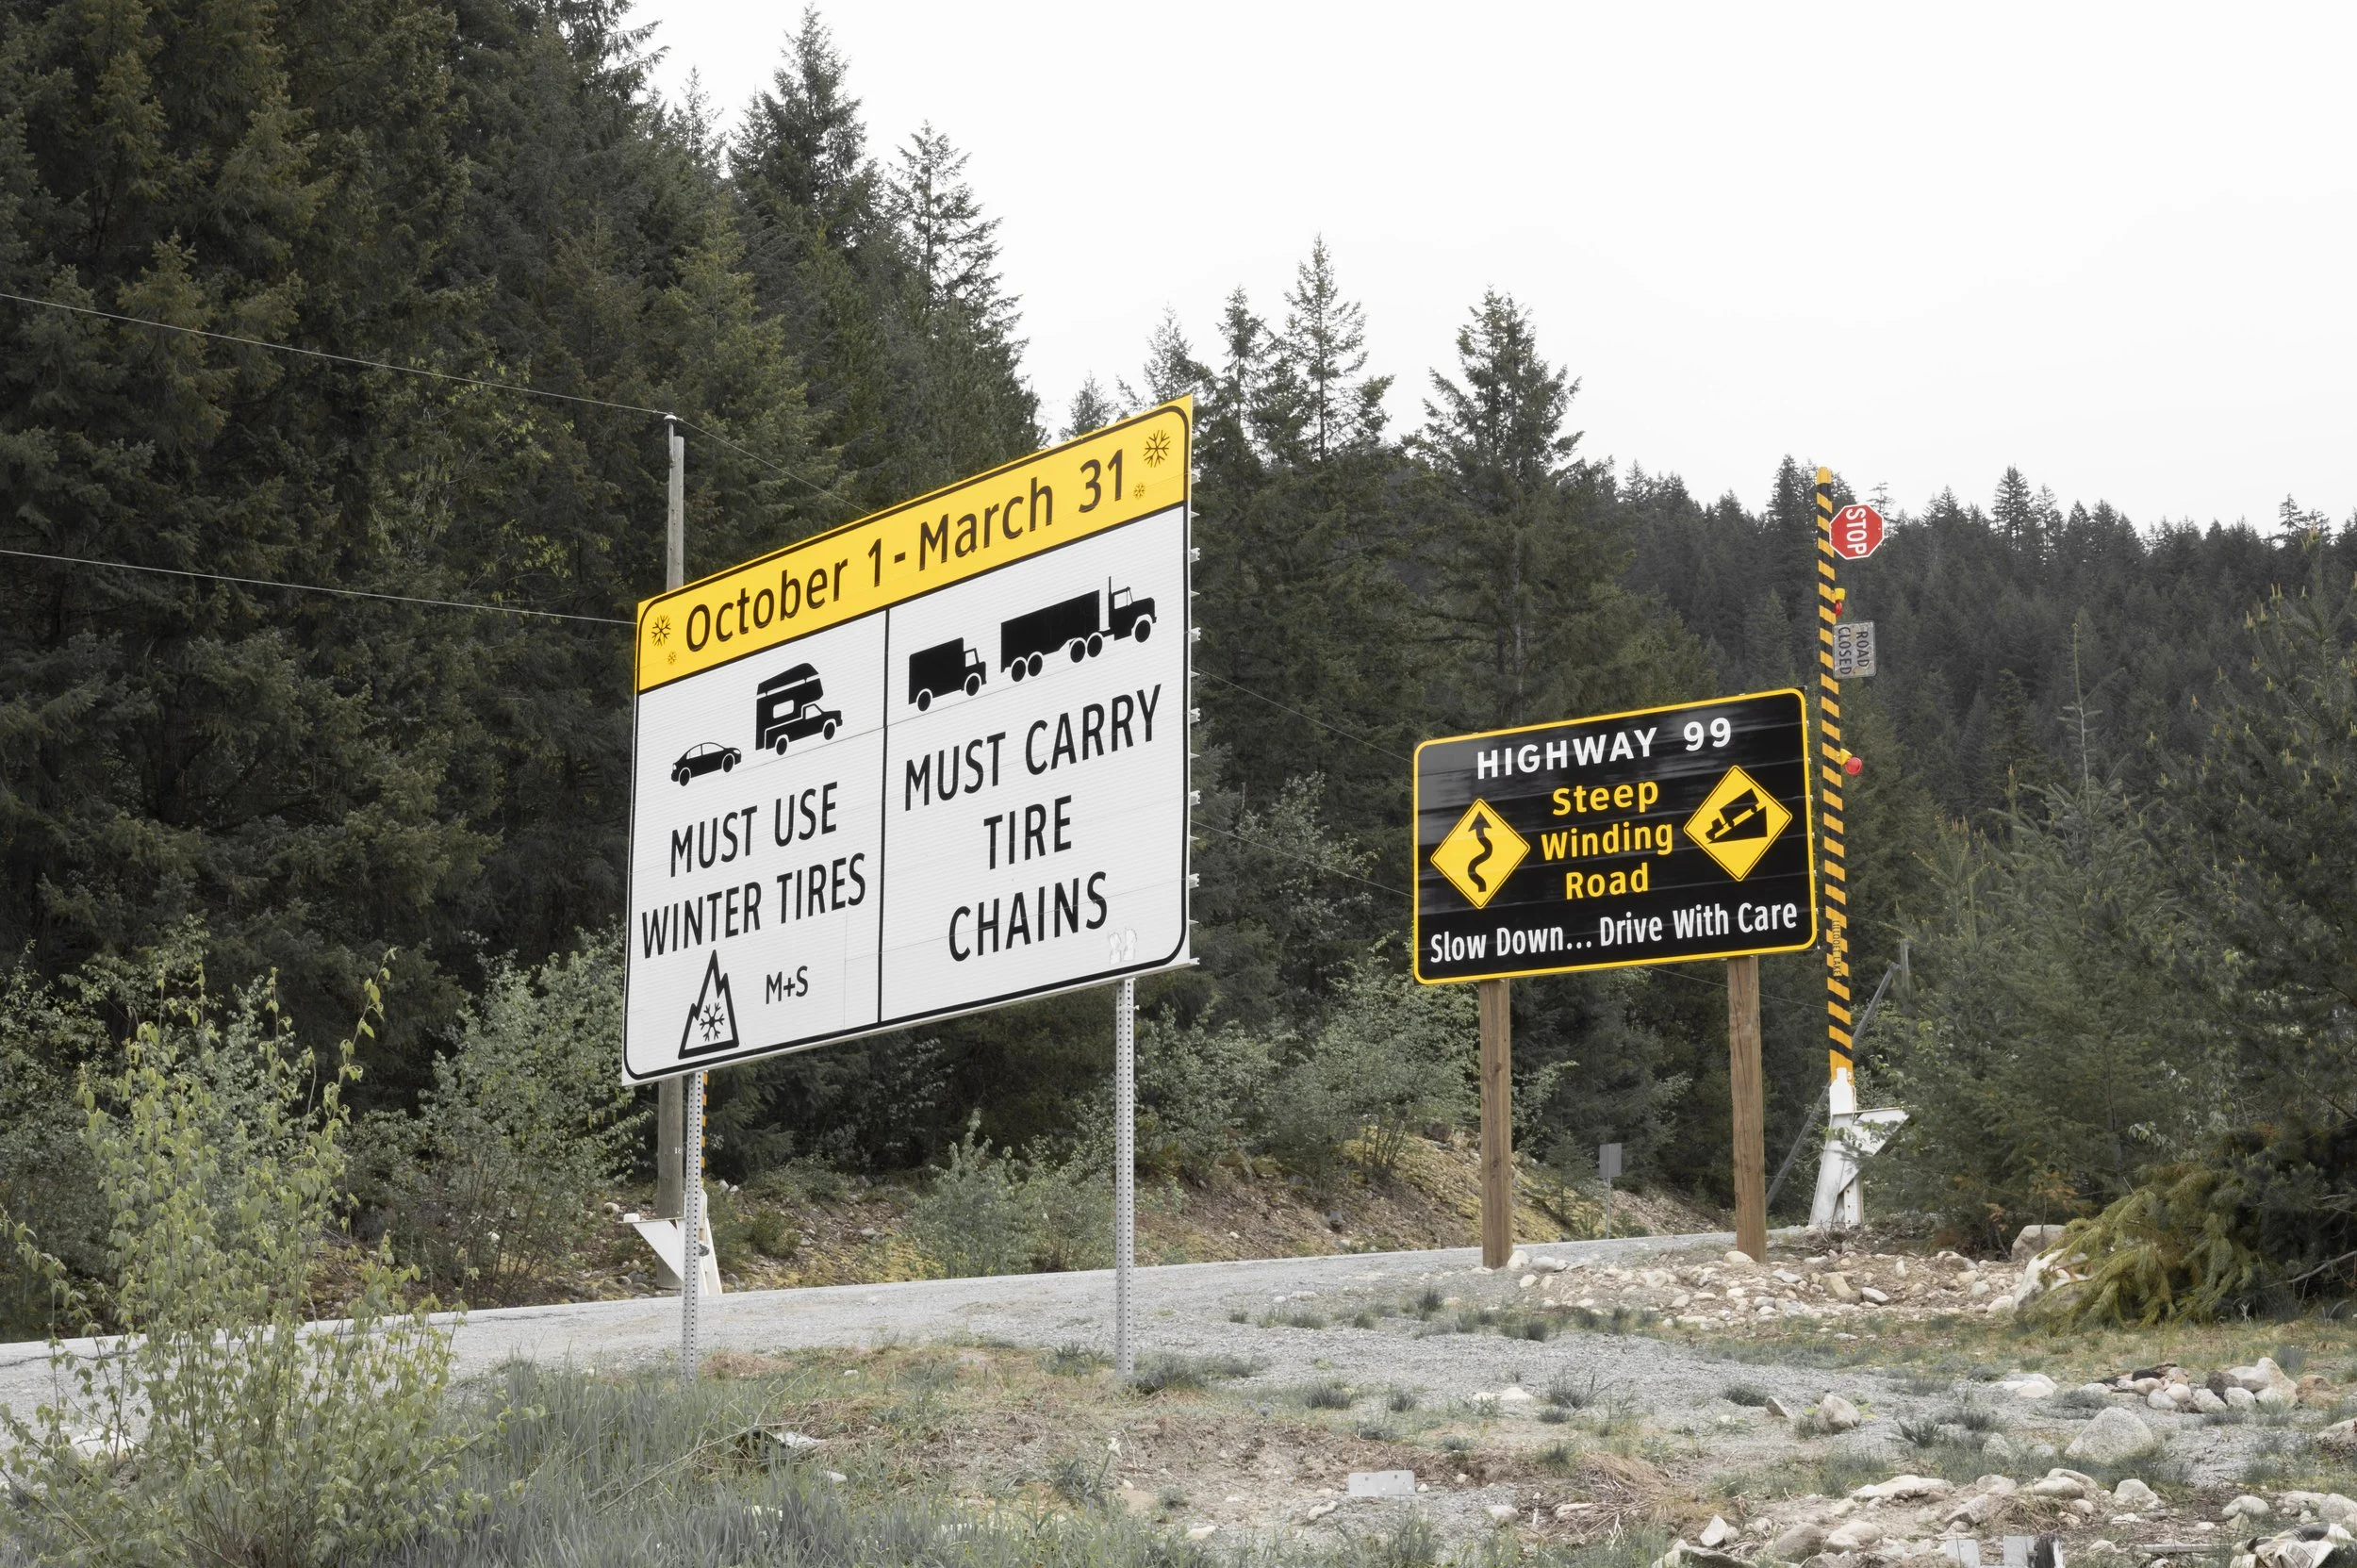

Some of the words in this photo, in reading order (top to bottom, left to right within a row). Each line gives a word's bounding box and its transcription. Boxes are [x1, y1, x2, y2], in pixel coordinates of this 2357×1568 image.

[686, 559, 848, 652] October
[1080, 450, 1122, 512] 31
[1846, 508, 1867, 554] STOP
[1838, 626, 1852, 675] CLOSED
[1855, 631, 1870, 668] ROAD
[905, 732, 1005, 811] MUST
[1026, 685, 1161, 775] CARRY
[1477, 728, 1656, 779] HIGHWAY
[1684, 718, 1731, 751] 99
[1553, 782, 1658, 816] Steep
[671, 805, 757, 877] MUST
[775, 782, 837, 847] USE
[984, 795, 1071, 869] TIRE
[1541, 822, 1673, 860] Winding
[642, 882, 761, 958] WINTER
[777, 853, 865, 924] TIRES
[1566, 863, 1648, 900] Road
[949, 871, 1107, 961] CHAINS
[1431, 932, 1486, 963] Slow
[1600, 912, 1662, 946] Drive
[1673, 903, 1728, 938] With
[1739, 903, 1797, 933] Care
[766, 966, 808, 1004] M+S
[1833, 956, 1841, 975] LAKE
